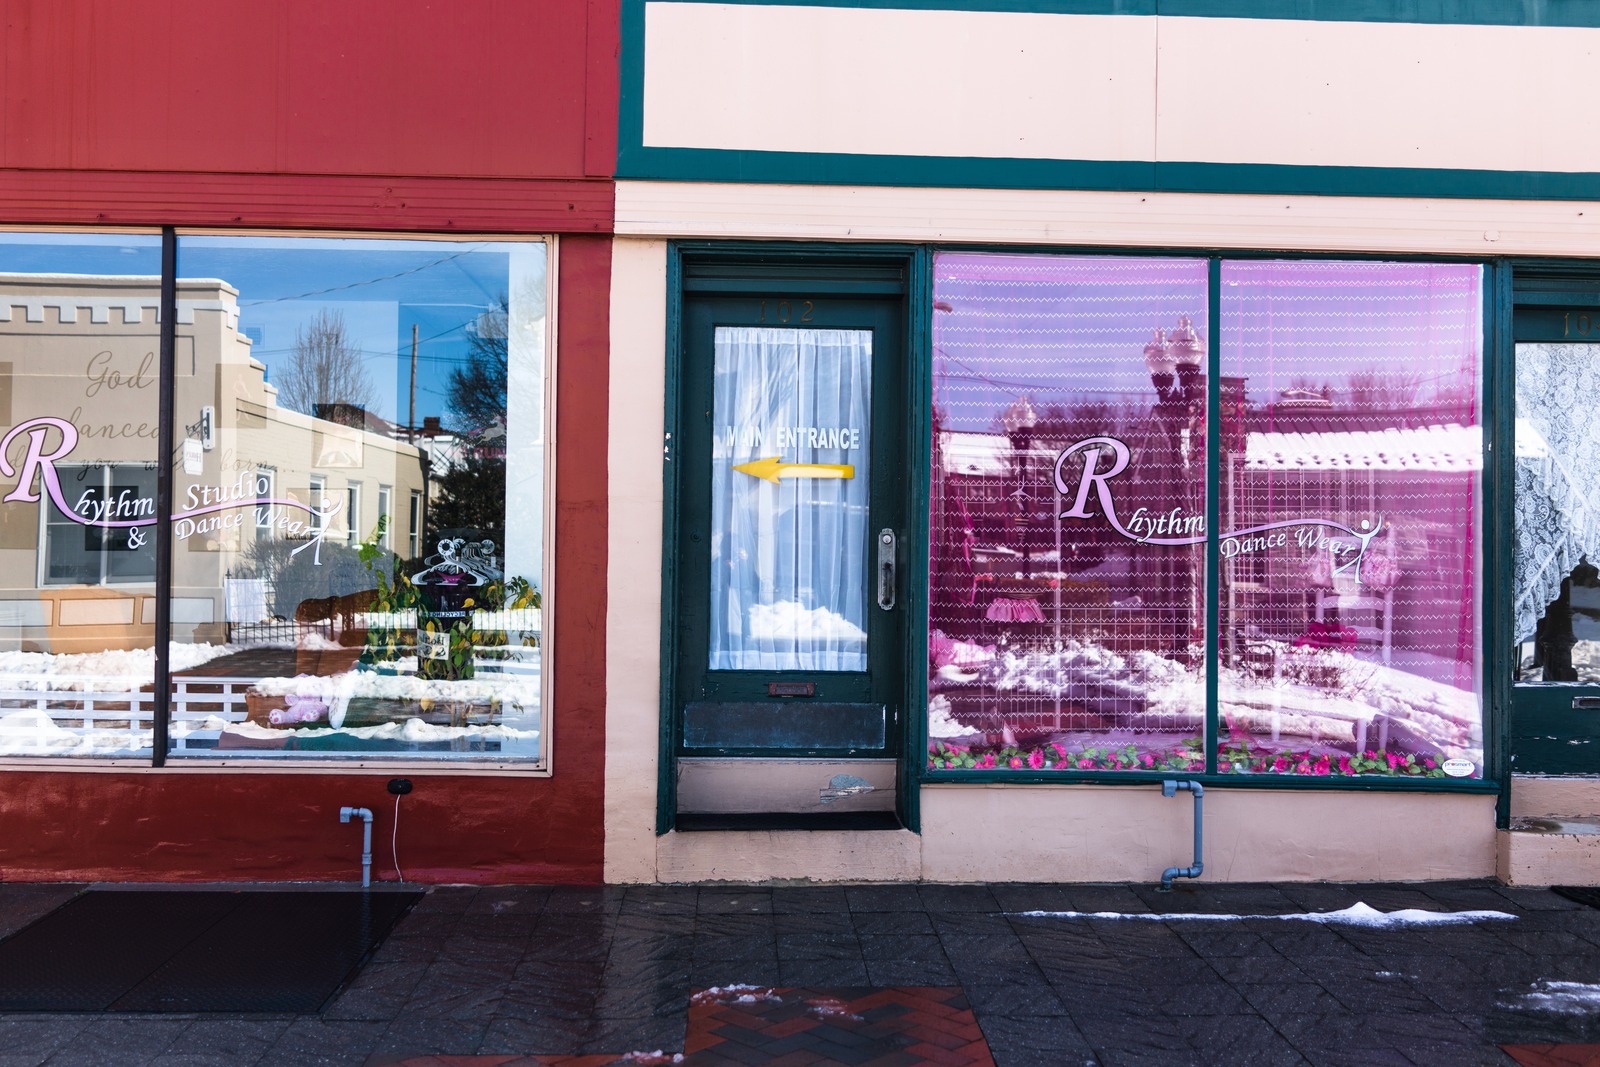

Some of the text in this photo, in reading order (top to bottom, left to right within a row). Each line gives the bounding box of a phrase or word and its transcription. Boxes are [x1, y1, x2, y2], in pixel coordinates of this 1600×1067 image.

[761, 300, 814, 323] 102
[1564, 312, 1600, 337] 10
[86, 350, 154, 397] God
[726, 425, 860, 449] MAIN ENTRANCE
[0, 416, 155, 528] Rhythm
[182, 470, 269, 511] Studio
[1054, 436, 1205, 543] Rhythm
[127, 505, 315, 550] & Dance Wear
[1220, 526, 1356, 559] Dance Wear
